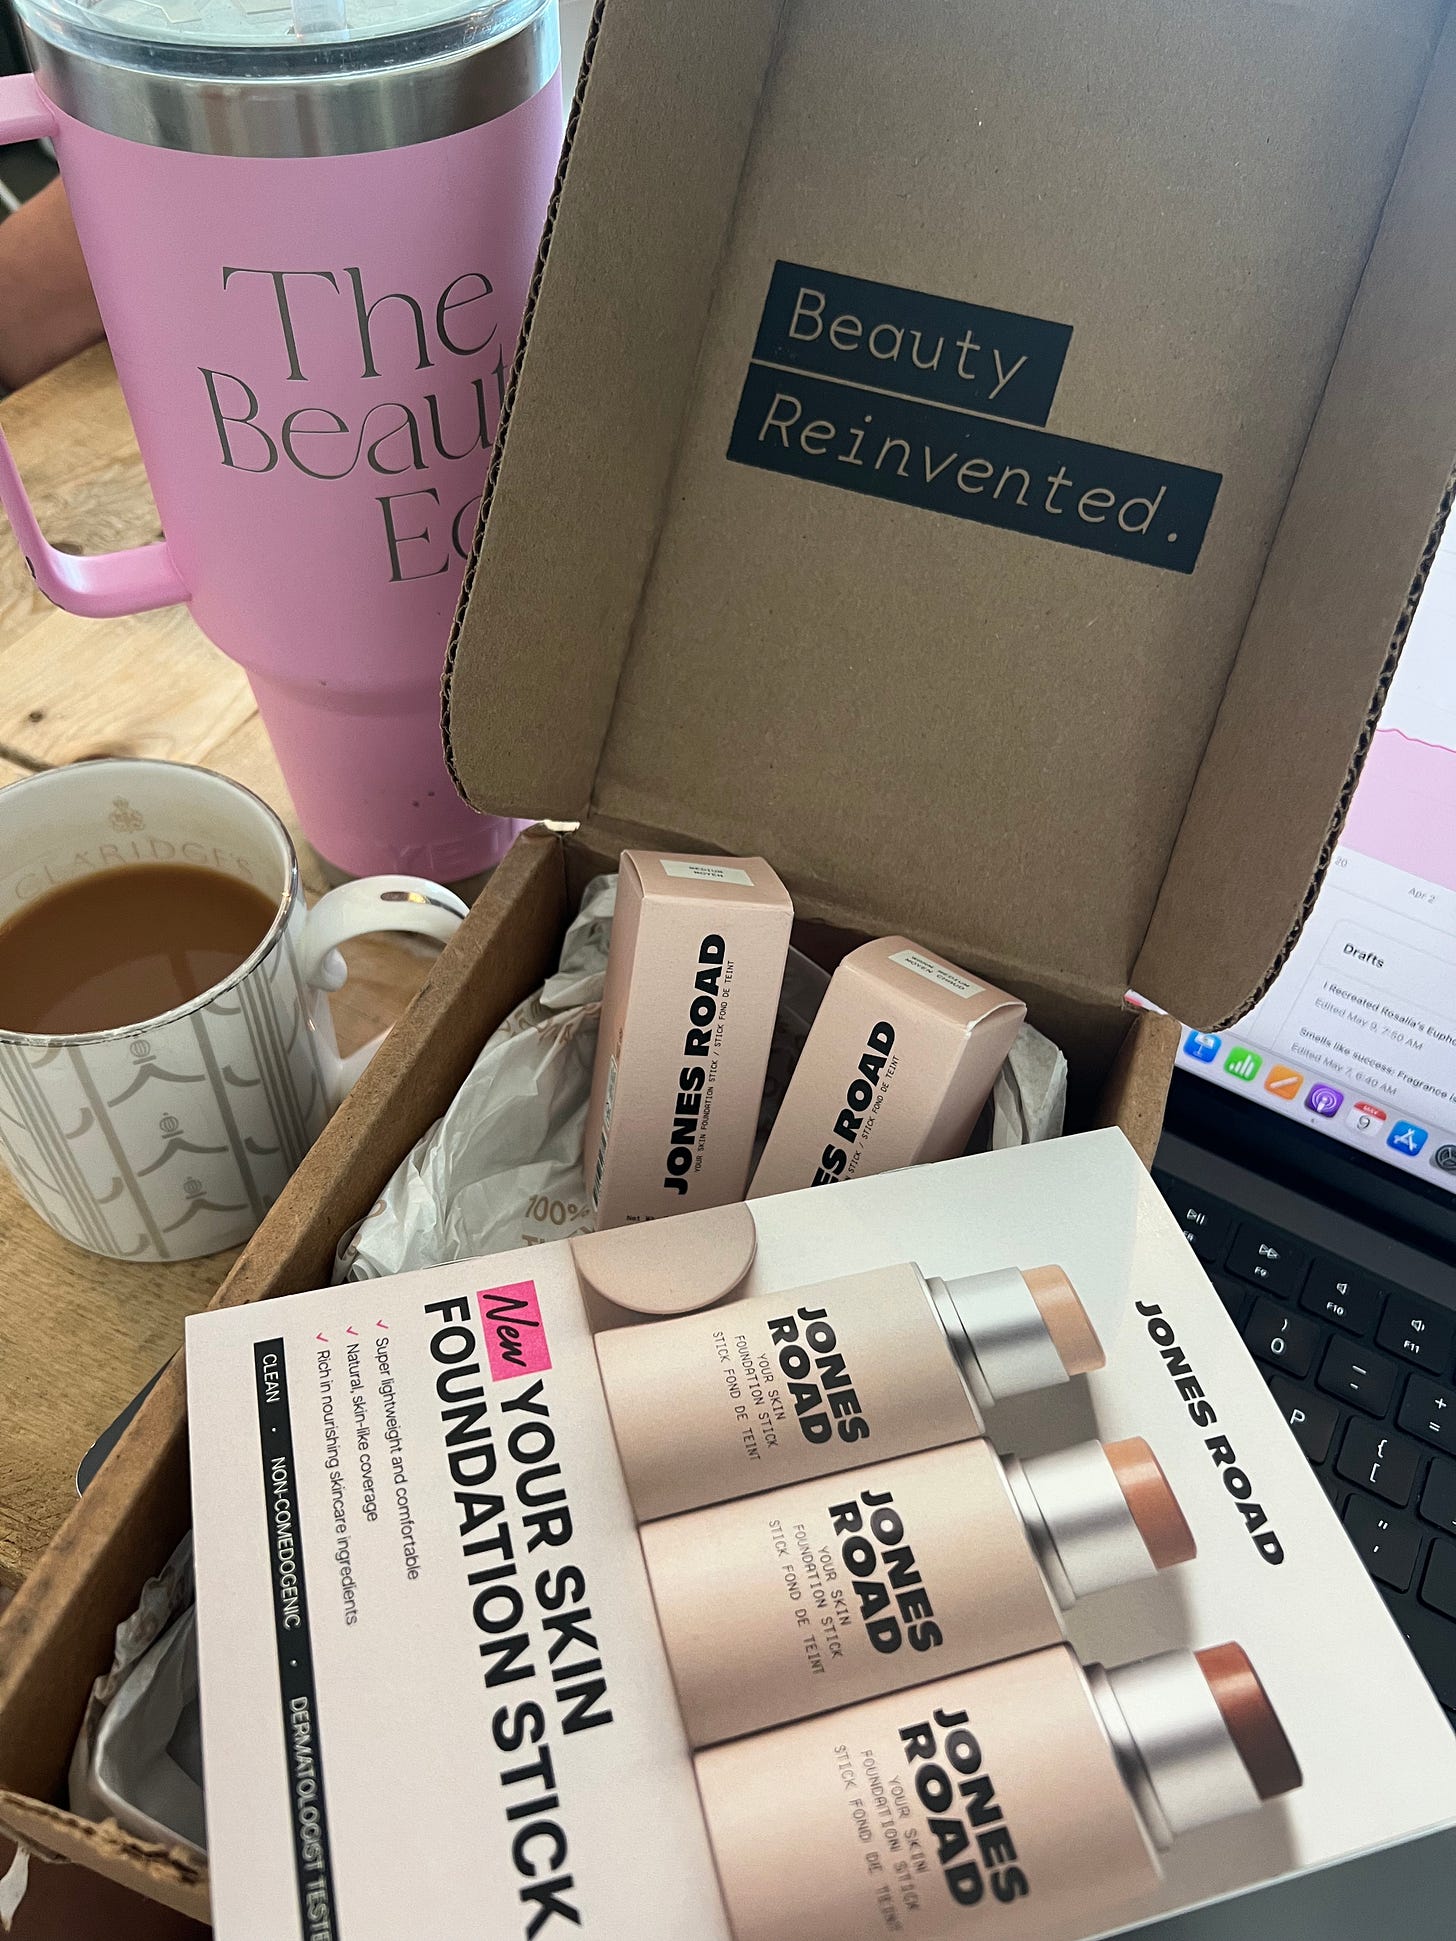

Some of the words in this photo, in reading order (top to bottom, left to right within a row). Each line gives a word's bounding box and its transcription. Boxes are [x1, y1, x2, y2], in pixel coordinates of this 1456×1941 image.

[222, 267, 499, 382] The
[788, 288, 1028, 400] Beauty
[758, 393, 1178, 544] Reinvented.
[724, 960, 734, 983] TEINT
[905, 957, 934, 974] MOYEN
[936, 974, 966, 991] CHAUD
[1343, 942, 1385, 969] Drafts
[684, 933, 727, 1057] ROAD
[718, 1001, 728, 1021] FOND
[722, 988, 731, 998] DE
[1314, 997, 1347, 1017] Edited
[1347, 1012, 1368, 1028] May
[1405, 1037, 1424, 1051] AM
[1329, 983, 1380, 1012] Recreated
[708, 1059, 719, 1082] STICK
[714, 1024, 725, 1048] STICK
[1290, 1042, 1322, 1062] Edited
[1322, 1057, 1343, 1073] May
[1379, 1083, 1397, 1097] AM
[1299, 1026, 1332, 1048] Smells
[1333, 1041, 1350, 1056] like
[1352, 1051, 1396, 1076] success:
[1397, 1069, 1448, 1099] Fragrance
[701, 1086, 714, 1132] FOUNDATION
[833, 1021, 896, 1144] ROAD
[848, 1151, 862, 1174] STICK
[861, 1118, 876, 1140] STICK
[872, 1095, 884, 1115] FOND
[880, 1082, 889, 1093] DE
[885, 1055, 900, 1079] TEINT
[664, 1065, 706, 1196] JONES
[698, 1134, 707, 1153] SKIN
[1357, 1115, 1371, 1130] 9
[694, 1154, 703, 1174] YOUR
[525, 1194, 591, 1226] 100%
[1254, 1266, 1268, 1278] F9
[1326, 1301, 1345, 1316] F10
[317, 1349, 331, 1379] Rich
[374, 1336, 391, 1376] Super
[482, 1293, 540, 1368] New
[1403, 1340, 1420, 1354] F11
[320, 1380, 333, 1393] in
[346, 1343, 364, 1394] Natural,
[713, 1331, 730, 1363] STICK
[724, 1368, 741, 1400] FOND
[734, 1405, 749, 1421] DE
[742, 1427, 761, 1461] TEINT
[734, 1335, 764, 1406] FOUNDATION
[759, 1412, 778, 1448] STICK
[756, 1353, 774, 1384] YOUR
[768, 1389, 786, 1420] SKIN
[767, 1315, 833, 1444] ROAD
[797, 1306, 870, 1443] JONES
[322, 1395, 340, 1469] nourishing
[352, 1395, 371, 1451] skin-like
[378, 1377, 403, 1454] lightweight
[1135, 1300, 1218, 1427] JONES
[1204, 1434, 1284, 1566] ROAD
[1290, 1408, 1306, 1425] P
[329, 1470, 347, 1534] skincare
[359, 1453, 378, 1522] coverage
[391, 1456, 408, 1485] and
[500, 1378, 573, 1553] YOUR
[395, 1487, 421, 1581] comfortable
[335, 1535, 358, 1626] ingredients
[769, 1519, 790, 1558] STICK
[782, 1564, 802, 1601] FOND
[794, 1608, 810, 1628] DE
[803, 1634, 825, 1675] TEINT
[793, 1524, 828, 1609] FOUNDATION
[821, 1617, 844, 1660] STICK
[818, 1545, 837, 1582] YOUR
[831, 1589, 851, 1627] SKIN
[828, 1500, 902, 1654] ROAD
[860, 1490, 943, 1652] JONES
[262, 1353, 280, 1404] CLEAN
[271, 1456, 301, 1631] NON-COMEDOGENIC
[290, 1696, 325, 1872] DERMATOLOGIST
[424, 1295, 536, 1688] FOUNDATION
[491, 1700, 582, 1941] STICK
[535, 1565, 614, 1735] SKIN
[898, 1720, 984, 1906] ROAD
[933, 1707, 1030, 1904] JONES
